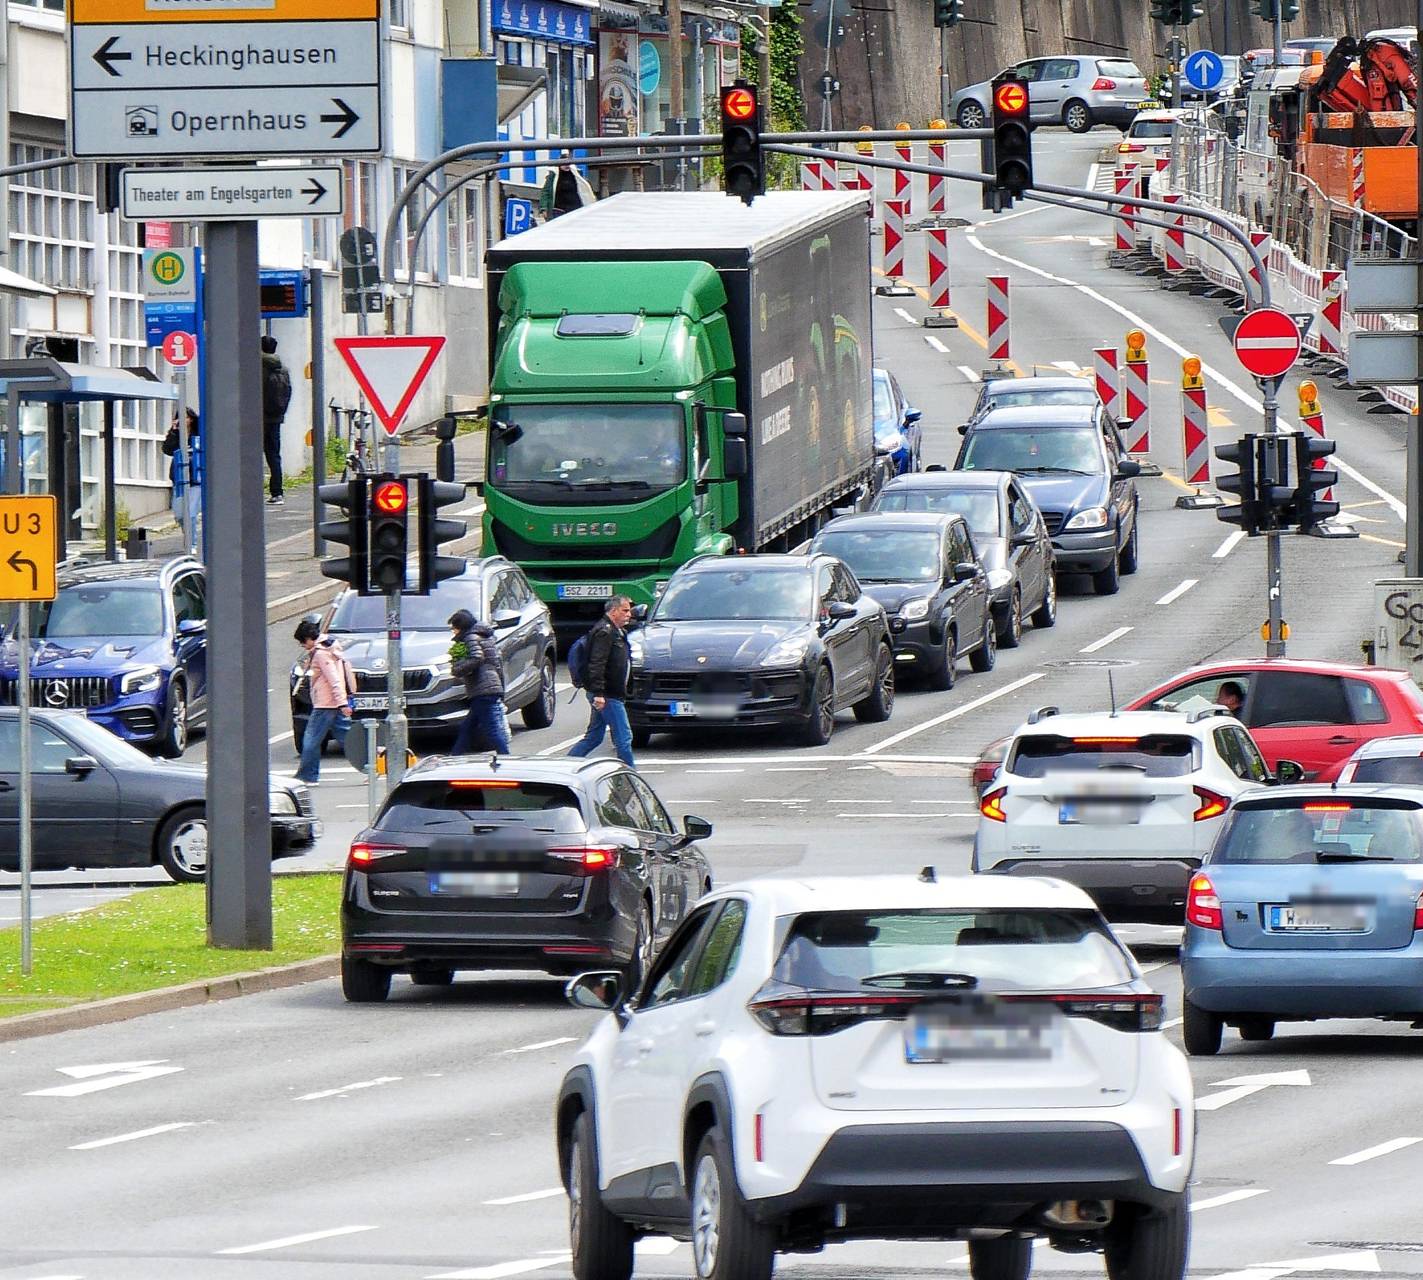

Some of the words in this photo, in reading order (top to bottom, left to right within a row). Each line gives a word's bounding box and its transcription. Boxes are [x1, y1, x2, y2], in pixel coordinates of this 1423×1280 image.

[146, 43, 337, 71] Heckinghausen
[171, 109, 307, 137] Opernhaus
[132, 187, 179, 202] Theater
[186, 190, 204, 201] am
[211, 186, 293, 203] Engelsgarten
[512, 204, 526, 231] P
[552, 522, 617, 536] IVECO
[587, 586, 608, 595] 2211
